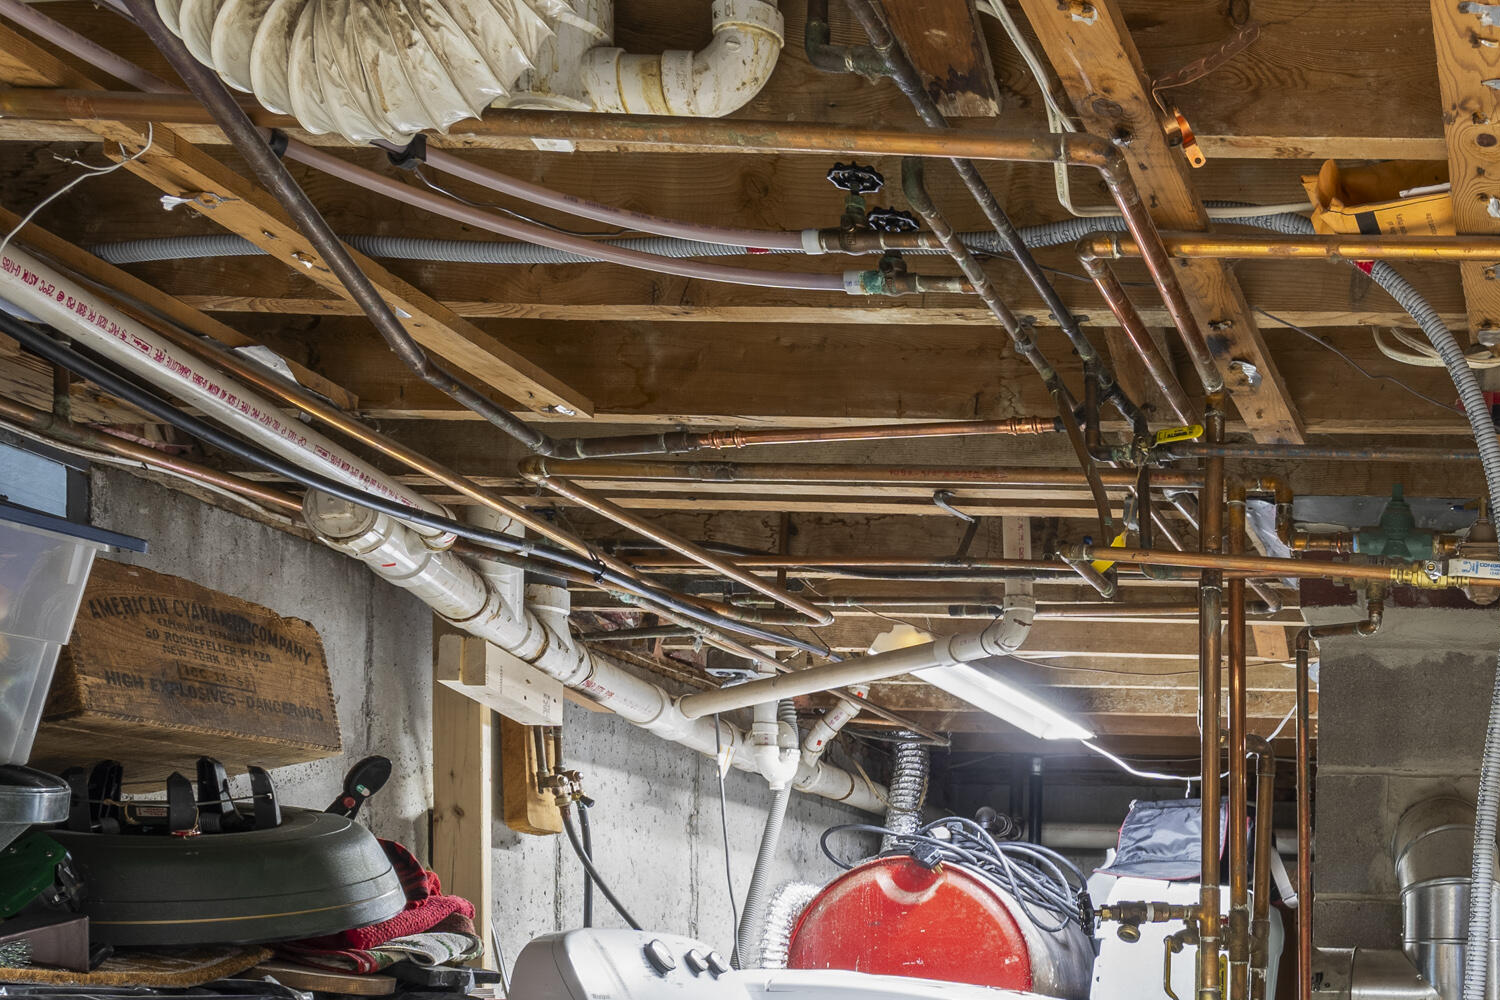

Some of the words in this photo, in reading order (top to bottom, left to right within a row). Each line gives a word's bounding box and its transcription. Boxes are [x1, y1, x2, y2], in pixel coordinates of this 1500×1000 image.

[19, 268, 39, 287] ASTM
[54, 290, 66, 303] @
[63, 295, 77, 310] PSI
[106, 322, 121, 337] PVC
[89, 595, 168, 619] AMERICAN
[252, 623, 311, 665] COMPANY
[165, 630, 236, 657] ROCKEFELLER
[162, 645, 187, 657] NEW
[193, 650, 221, 666] YORK
[105, 670, 145, 690] HIGH
